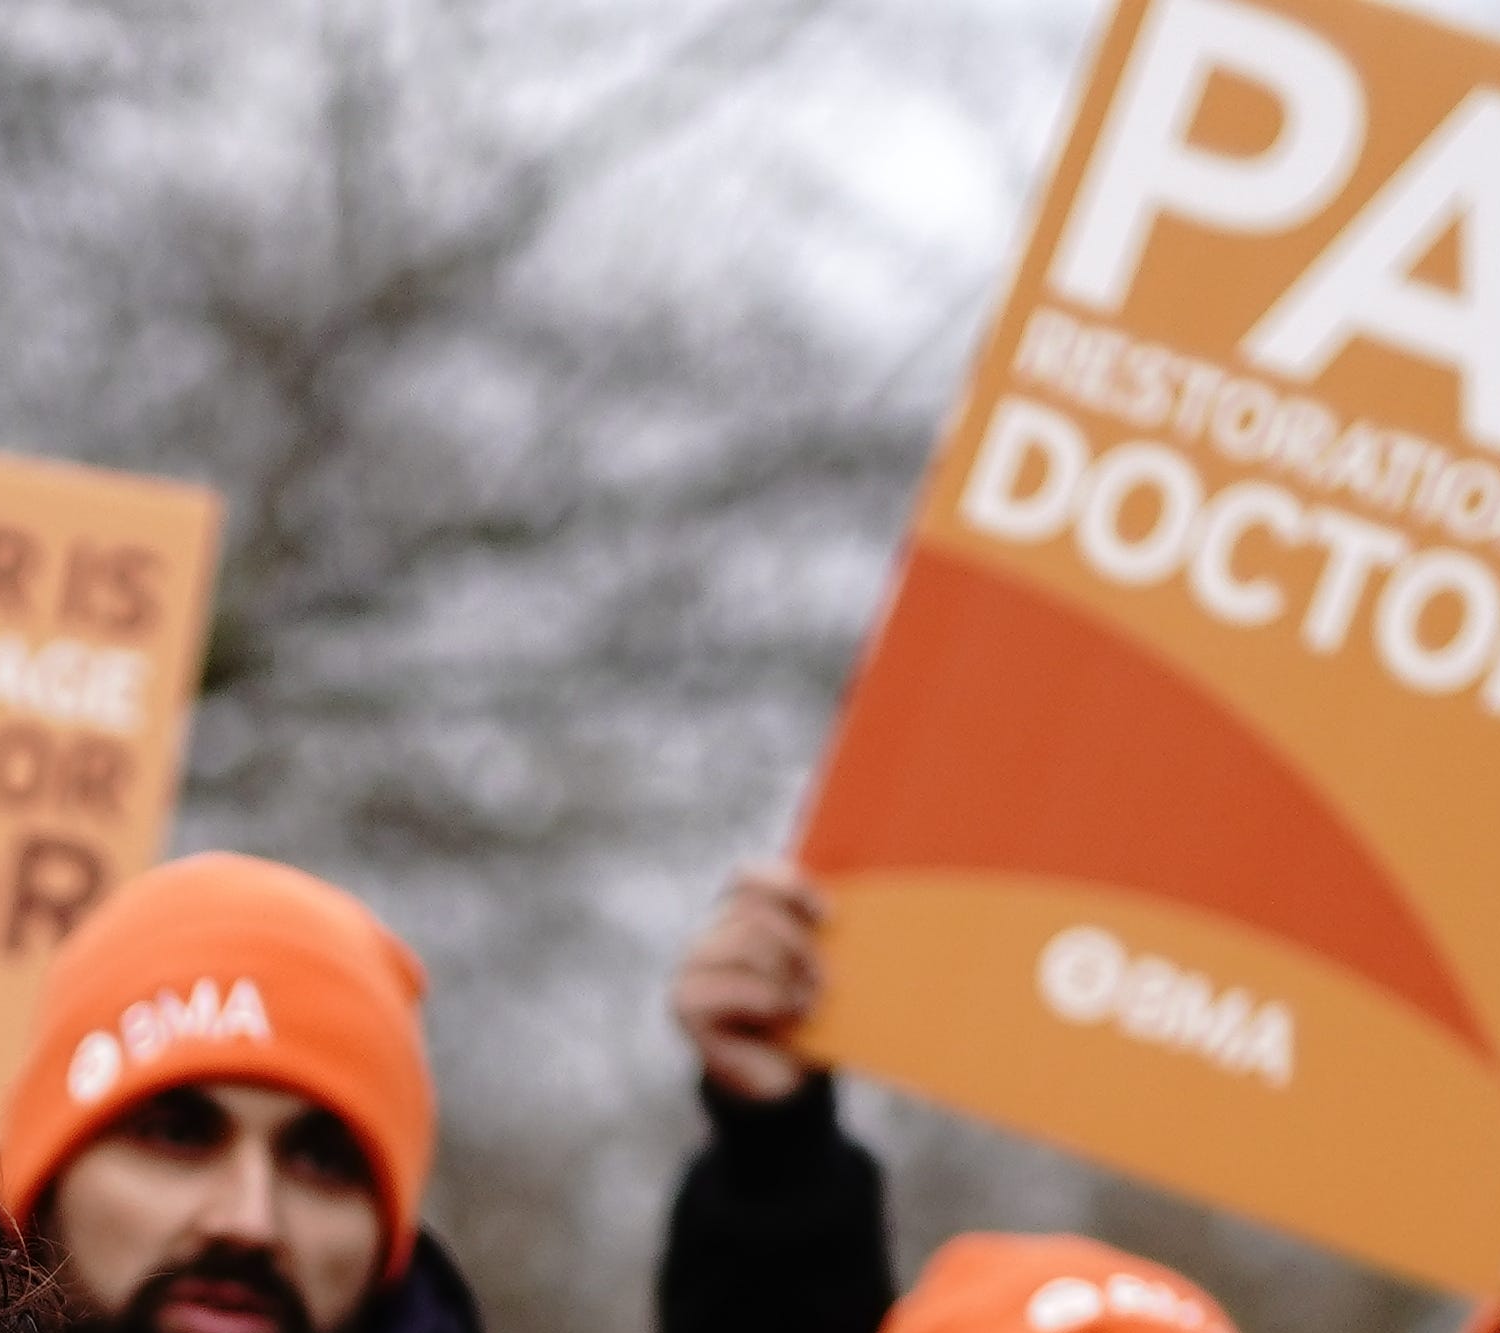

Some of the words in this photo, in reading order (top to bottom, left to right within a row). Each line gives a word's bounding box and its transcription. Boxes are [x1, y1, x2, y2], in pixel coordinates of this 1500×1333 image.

[59, 538, 166, 633] IS
[119, 976, 274, 1063] BMA
[1123, 949, 1296, 1088] BMA
